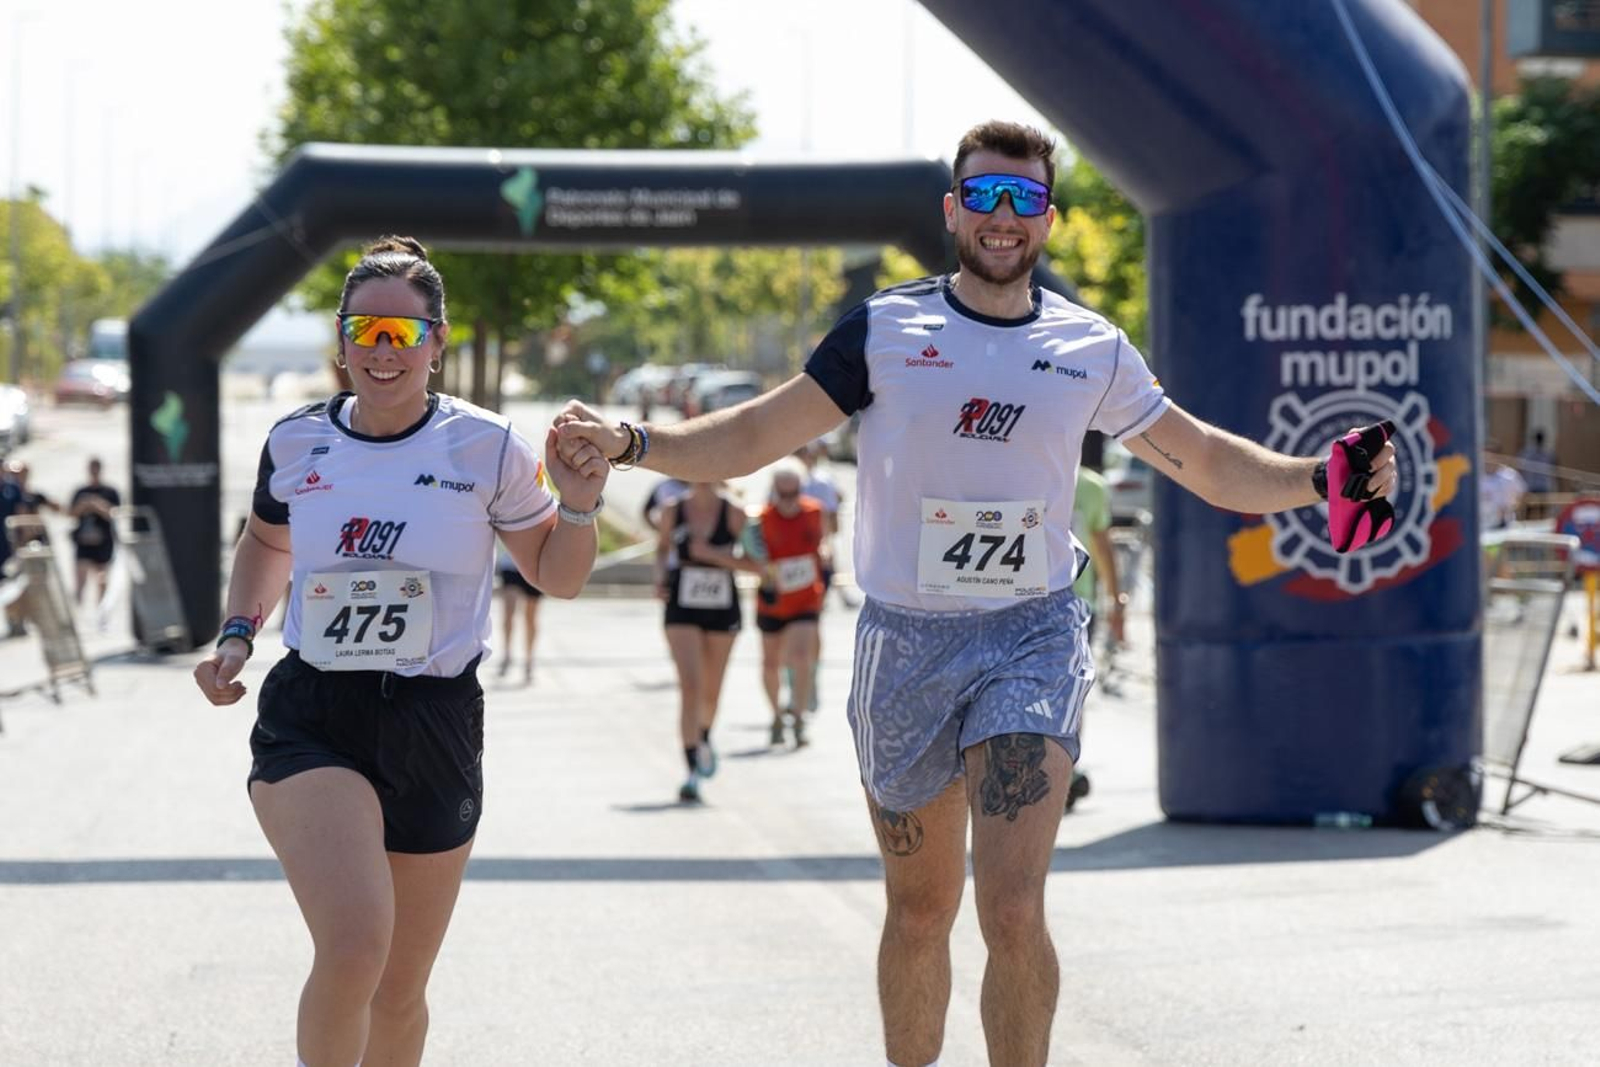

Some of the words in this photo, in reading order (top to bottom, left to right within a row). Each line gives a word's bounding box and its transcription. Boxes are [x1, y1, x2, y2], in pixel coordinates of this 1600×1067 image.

[1241, 292, 1452, 341] fundación
[905, 357, 954, 369] Santander
[1281, 340, 1419, 394] mupol
[1056, 365, 1087, 380] mupol
[440, 480, 475, 493] mupol
[942, 532, 1025, 572] 474
[982, 577, 999, 585] CANO
[323, 604, 408, 644] 475
[335, 649, 353, 657] LAURA
